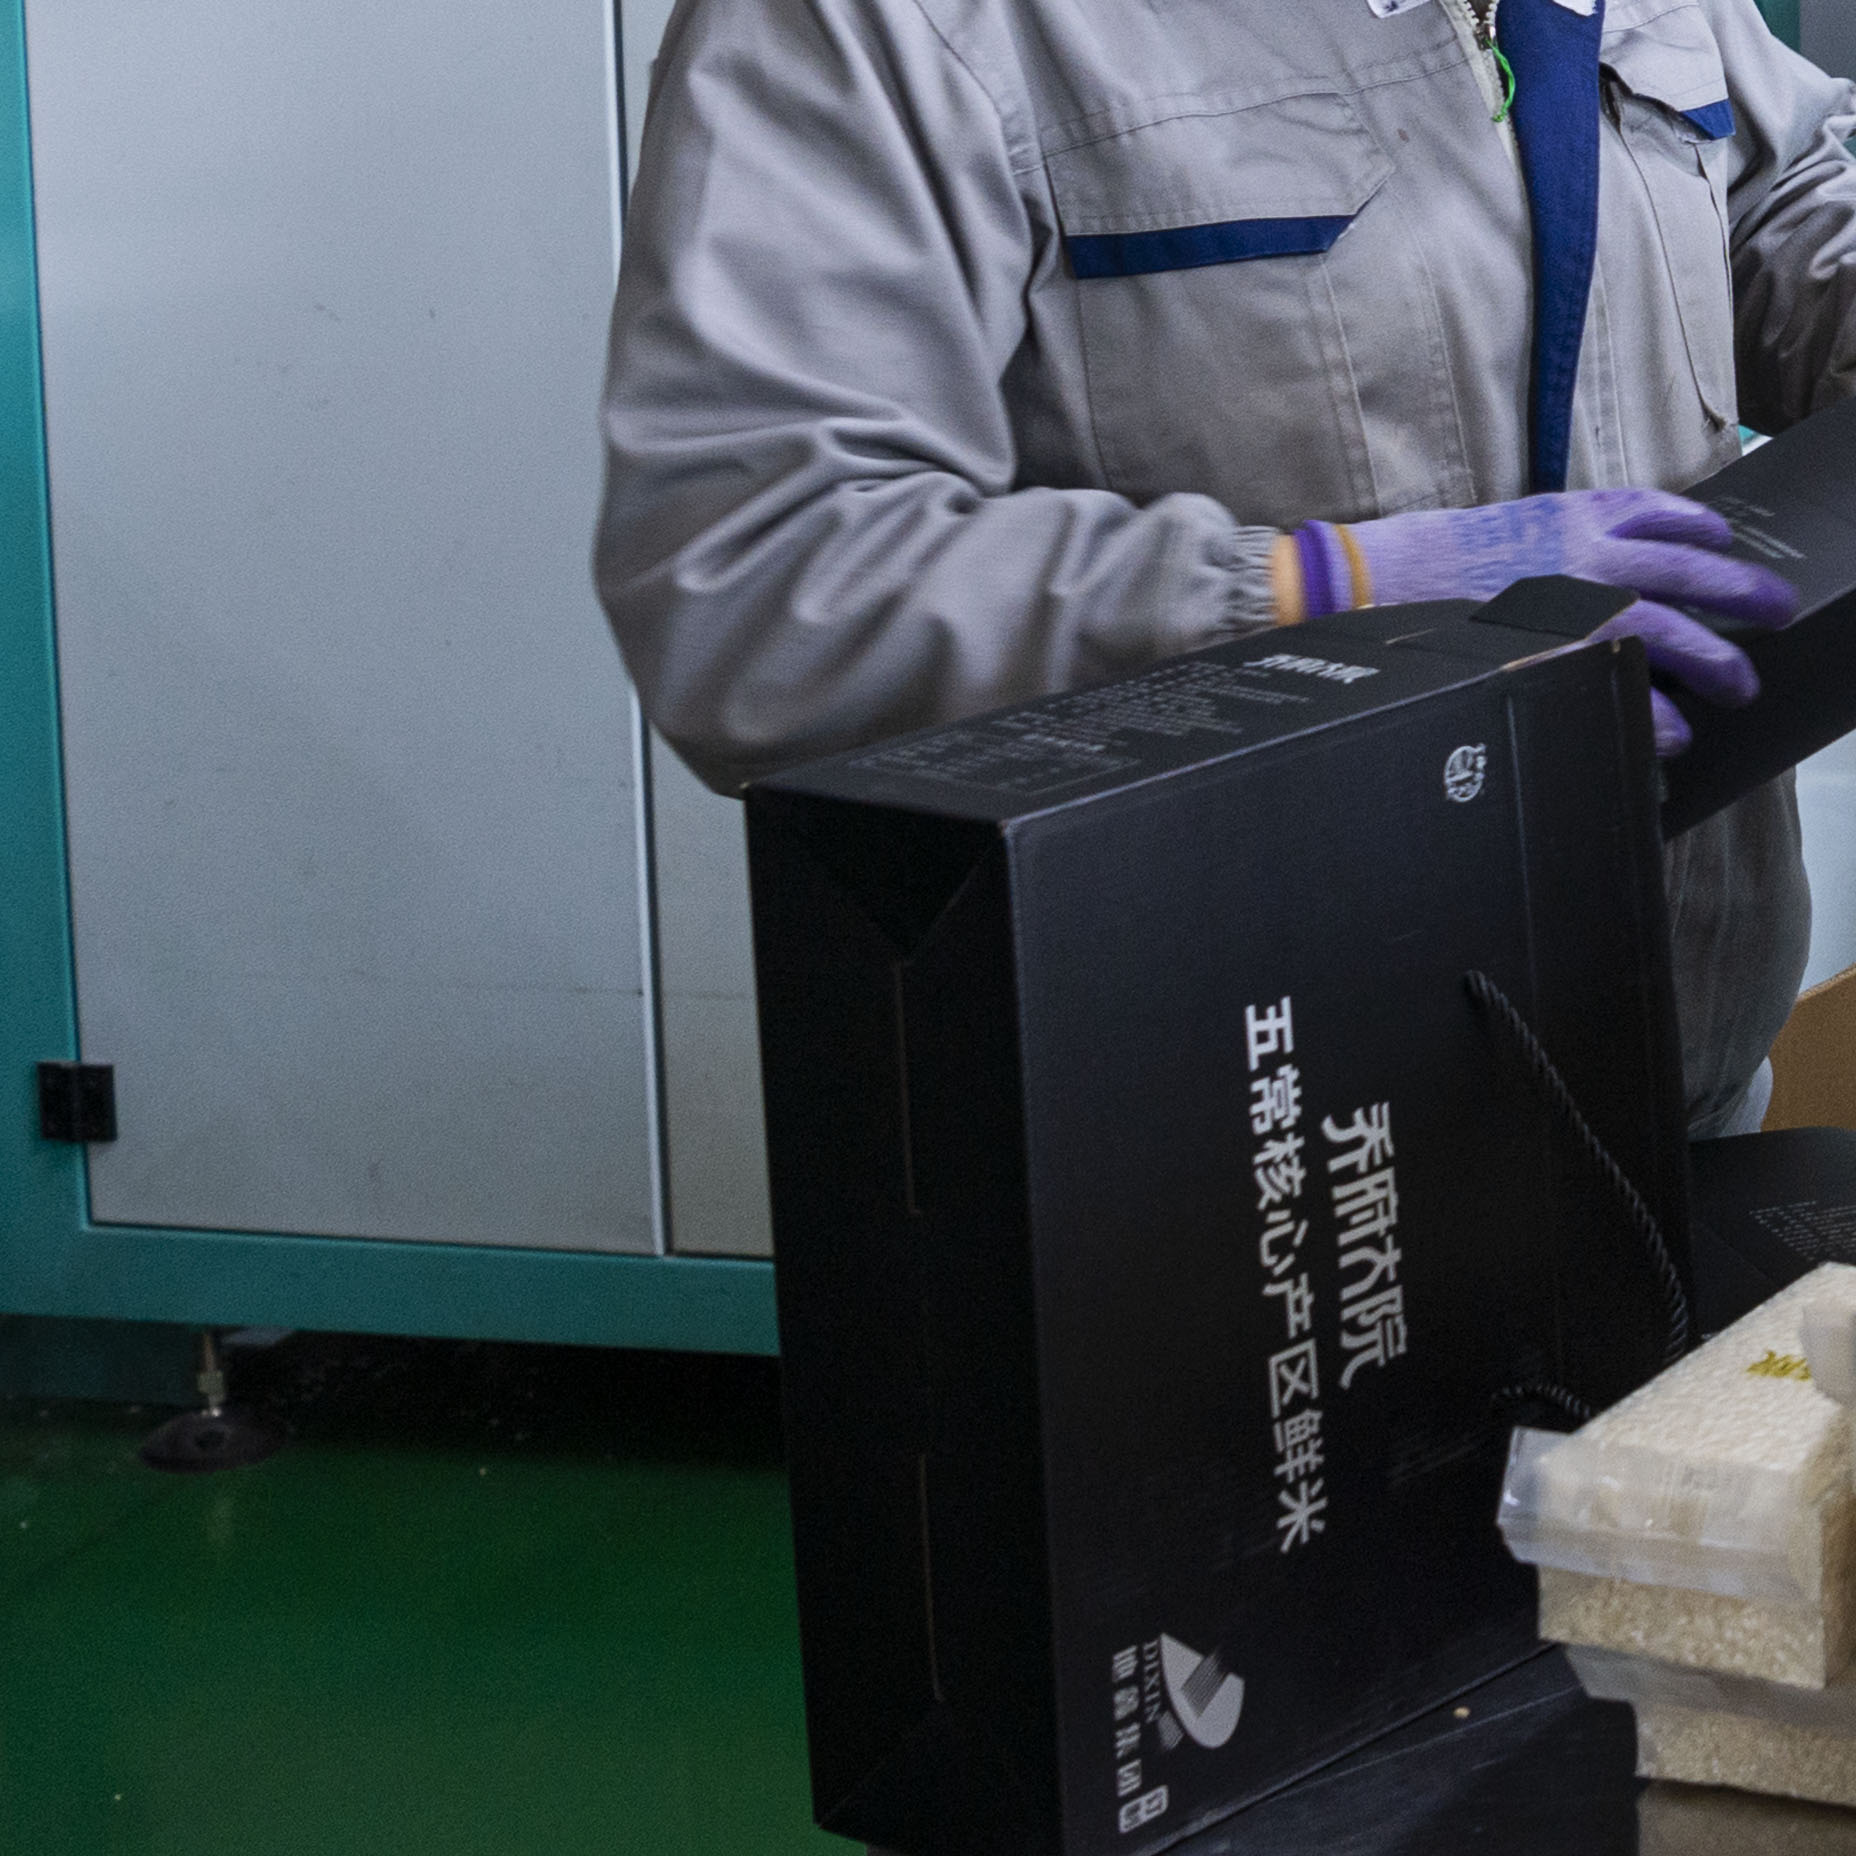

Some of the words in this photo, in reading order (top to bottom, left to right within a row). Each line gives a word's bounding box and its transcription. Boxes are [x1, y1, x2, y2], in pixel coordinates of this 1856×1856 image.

[1243, 994, 1329, 1554] 五常核心产区鲜米
[1321, 1100, 1408, 1390] 乔府大院
